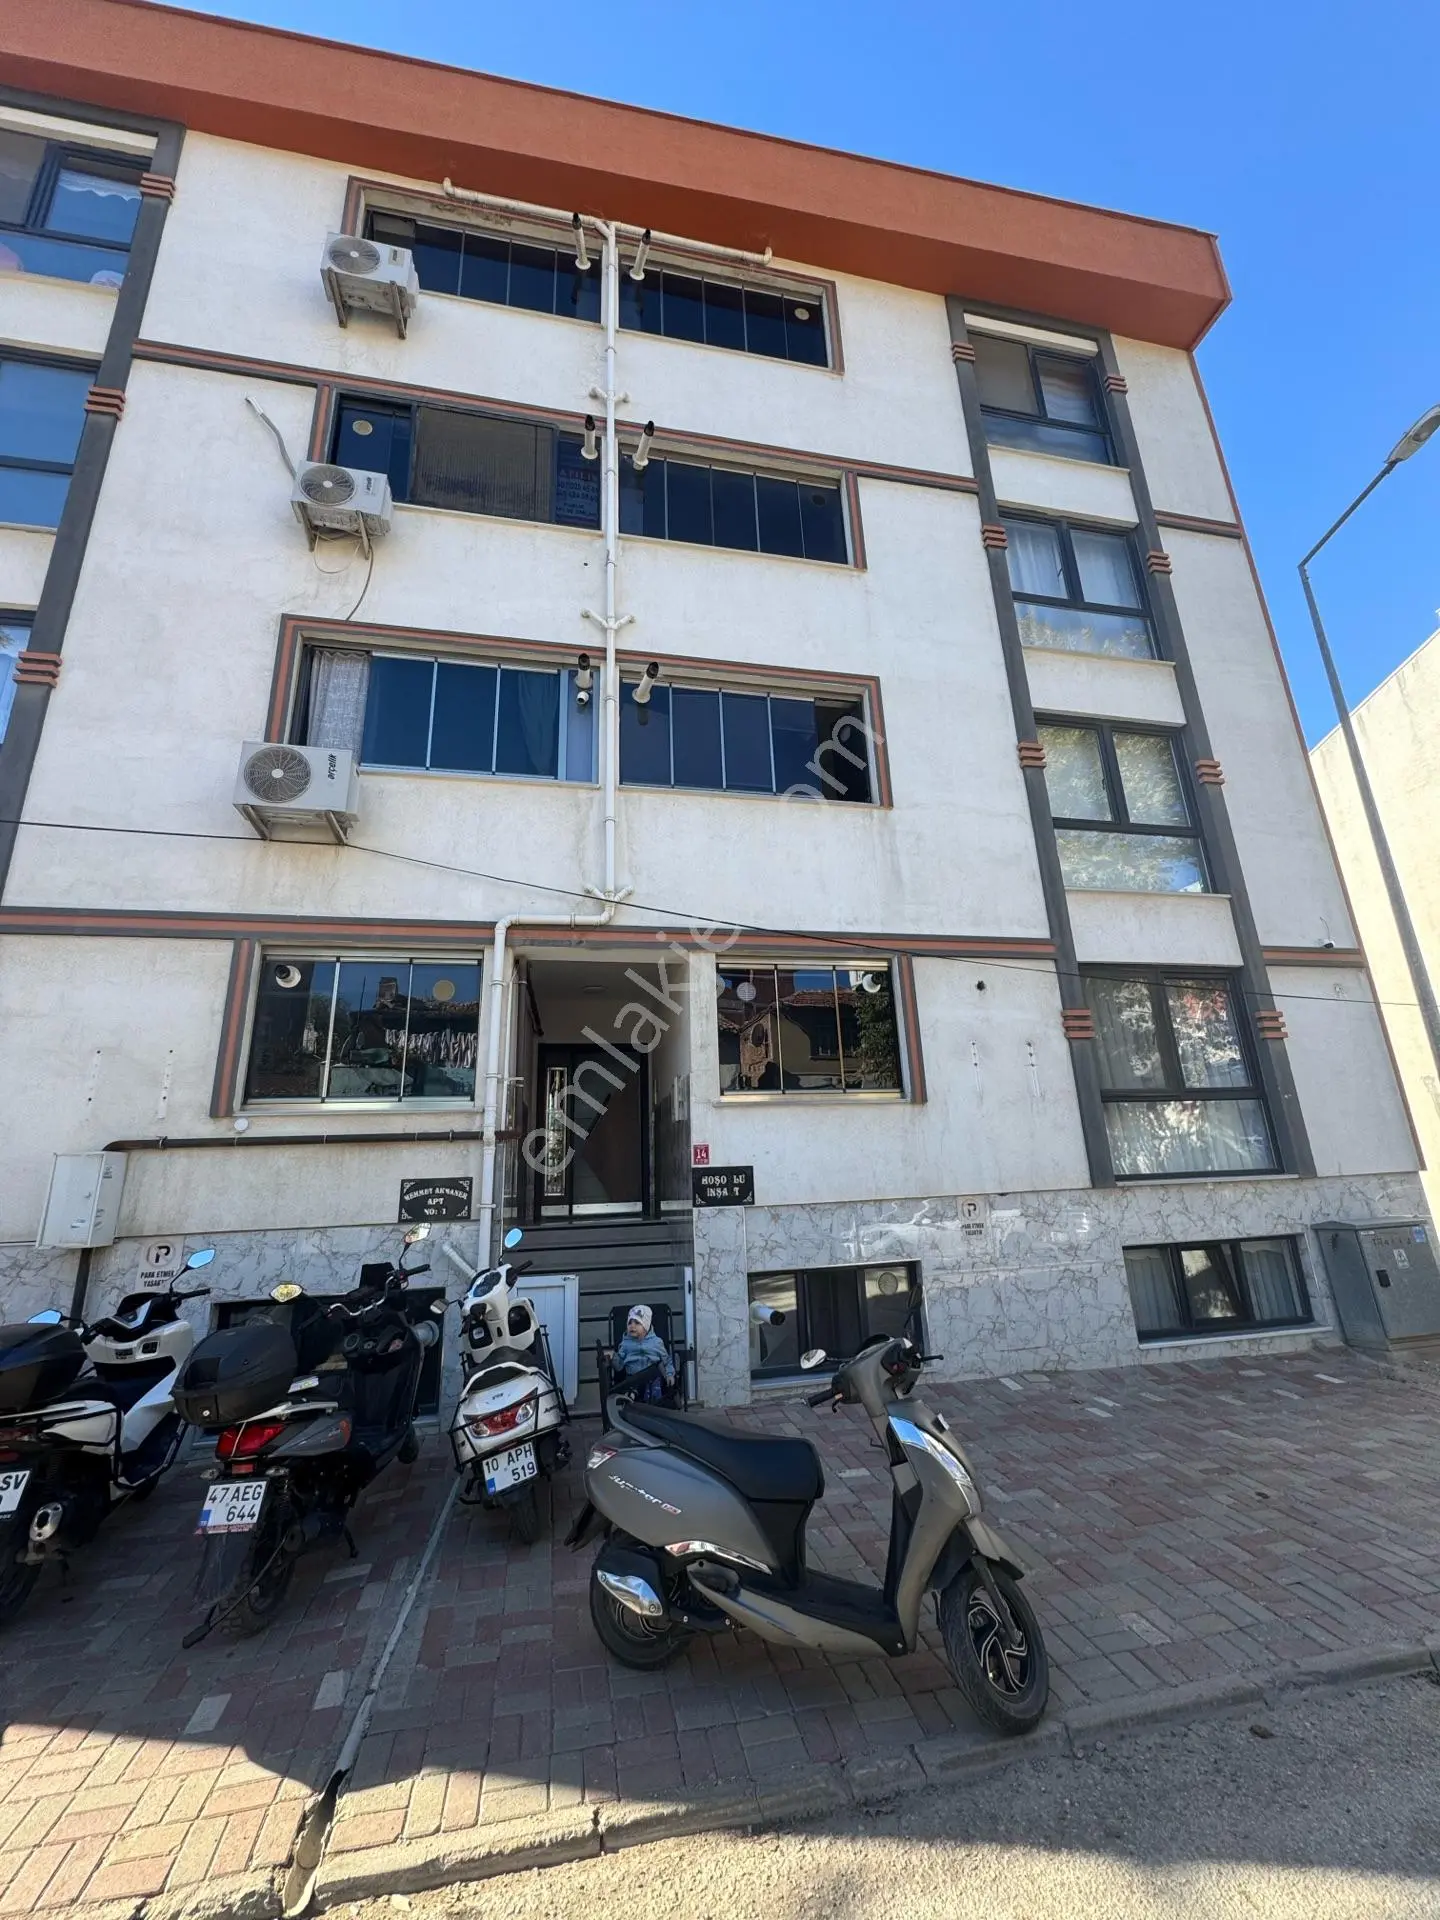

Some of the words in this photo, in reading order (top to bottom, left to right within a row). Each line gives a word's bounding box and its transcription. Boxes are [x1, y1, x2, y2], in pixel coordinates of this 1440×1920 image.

[696, 1149, 707, 1158] 14
[427, 1197, 445, 1205] APT
[141, 1271, 155, 1279] PARK
[485, 1458, 499, 1474] 10
[507, 1443, 533, 1466] APH
[512, 1461, 536, 1481] 519
[208, 1487, 231, 1504] 47
[230, 1484, 263, 1502] AEG
[226, 1503, 257, 1522] 644
